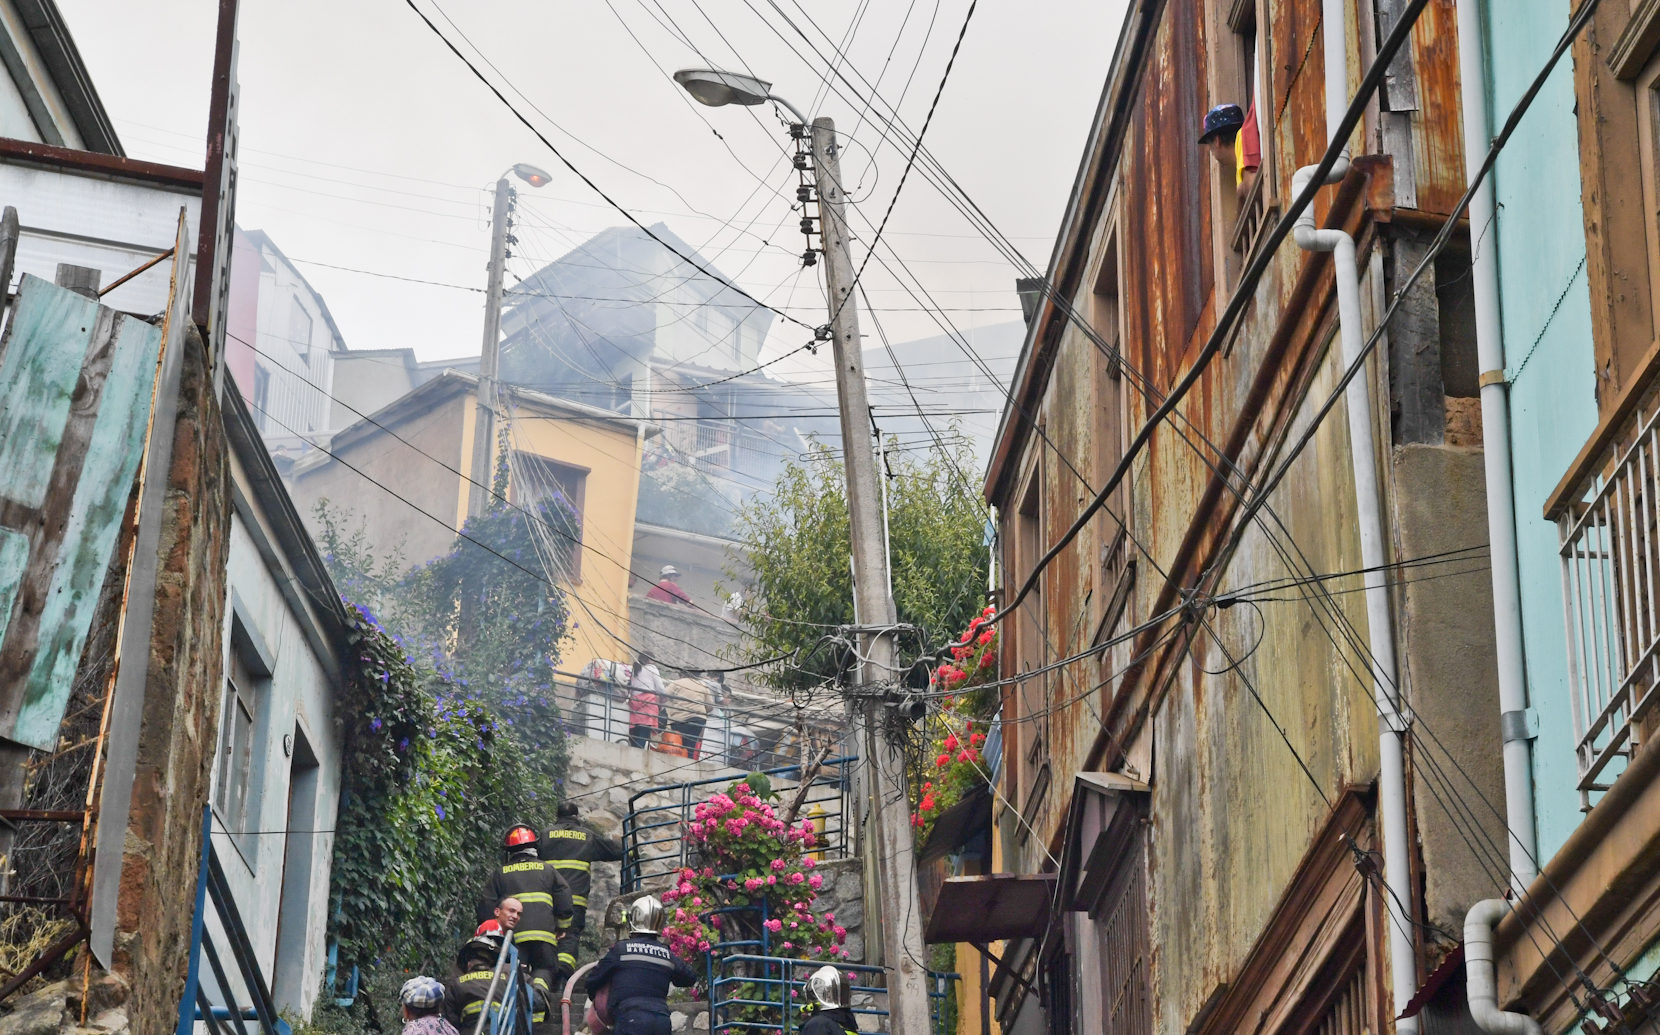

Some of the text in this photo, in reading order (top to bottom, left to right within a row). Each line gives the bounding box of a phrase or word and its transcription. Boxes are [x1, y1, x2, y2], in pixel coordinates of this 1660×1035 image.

[549, 829, 586, 840] BOMBEROS
[502, 861, 544, 874] BOMBEROS
[626, 946, 670, 960] MARSEILLE
[458, 970, 506, 983] BOMBERS
